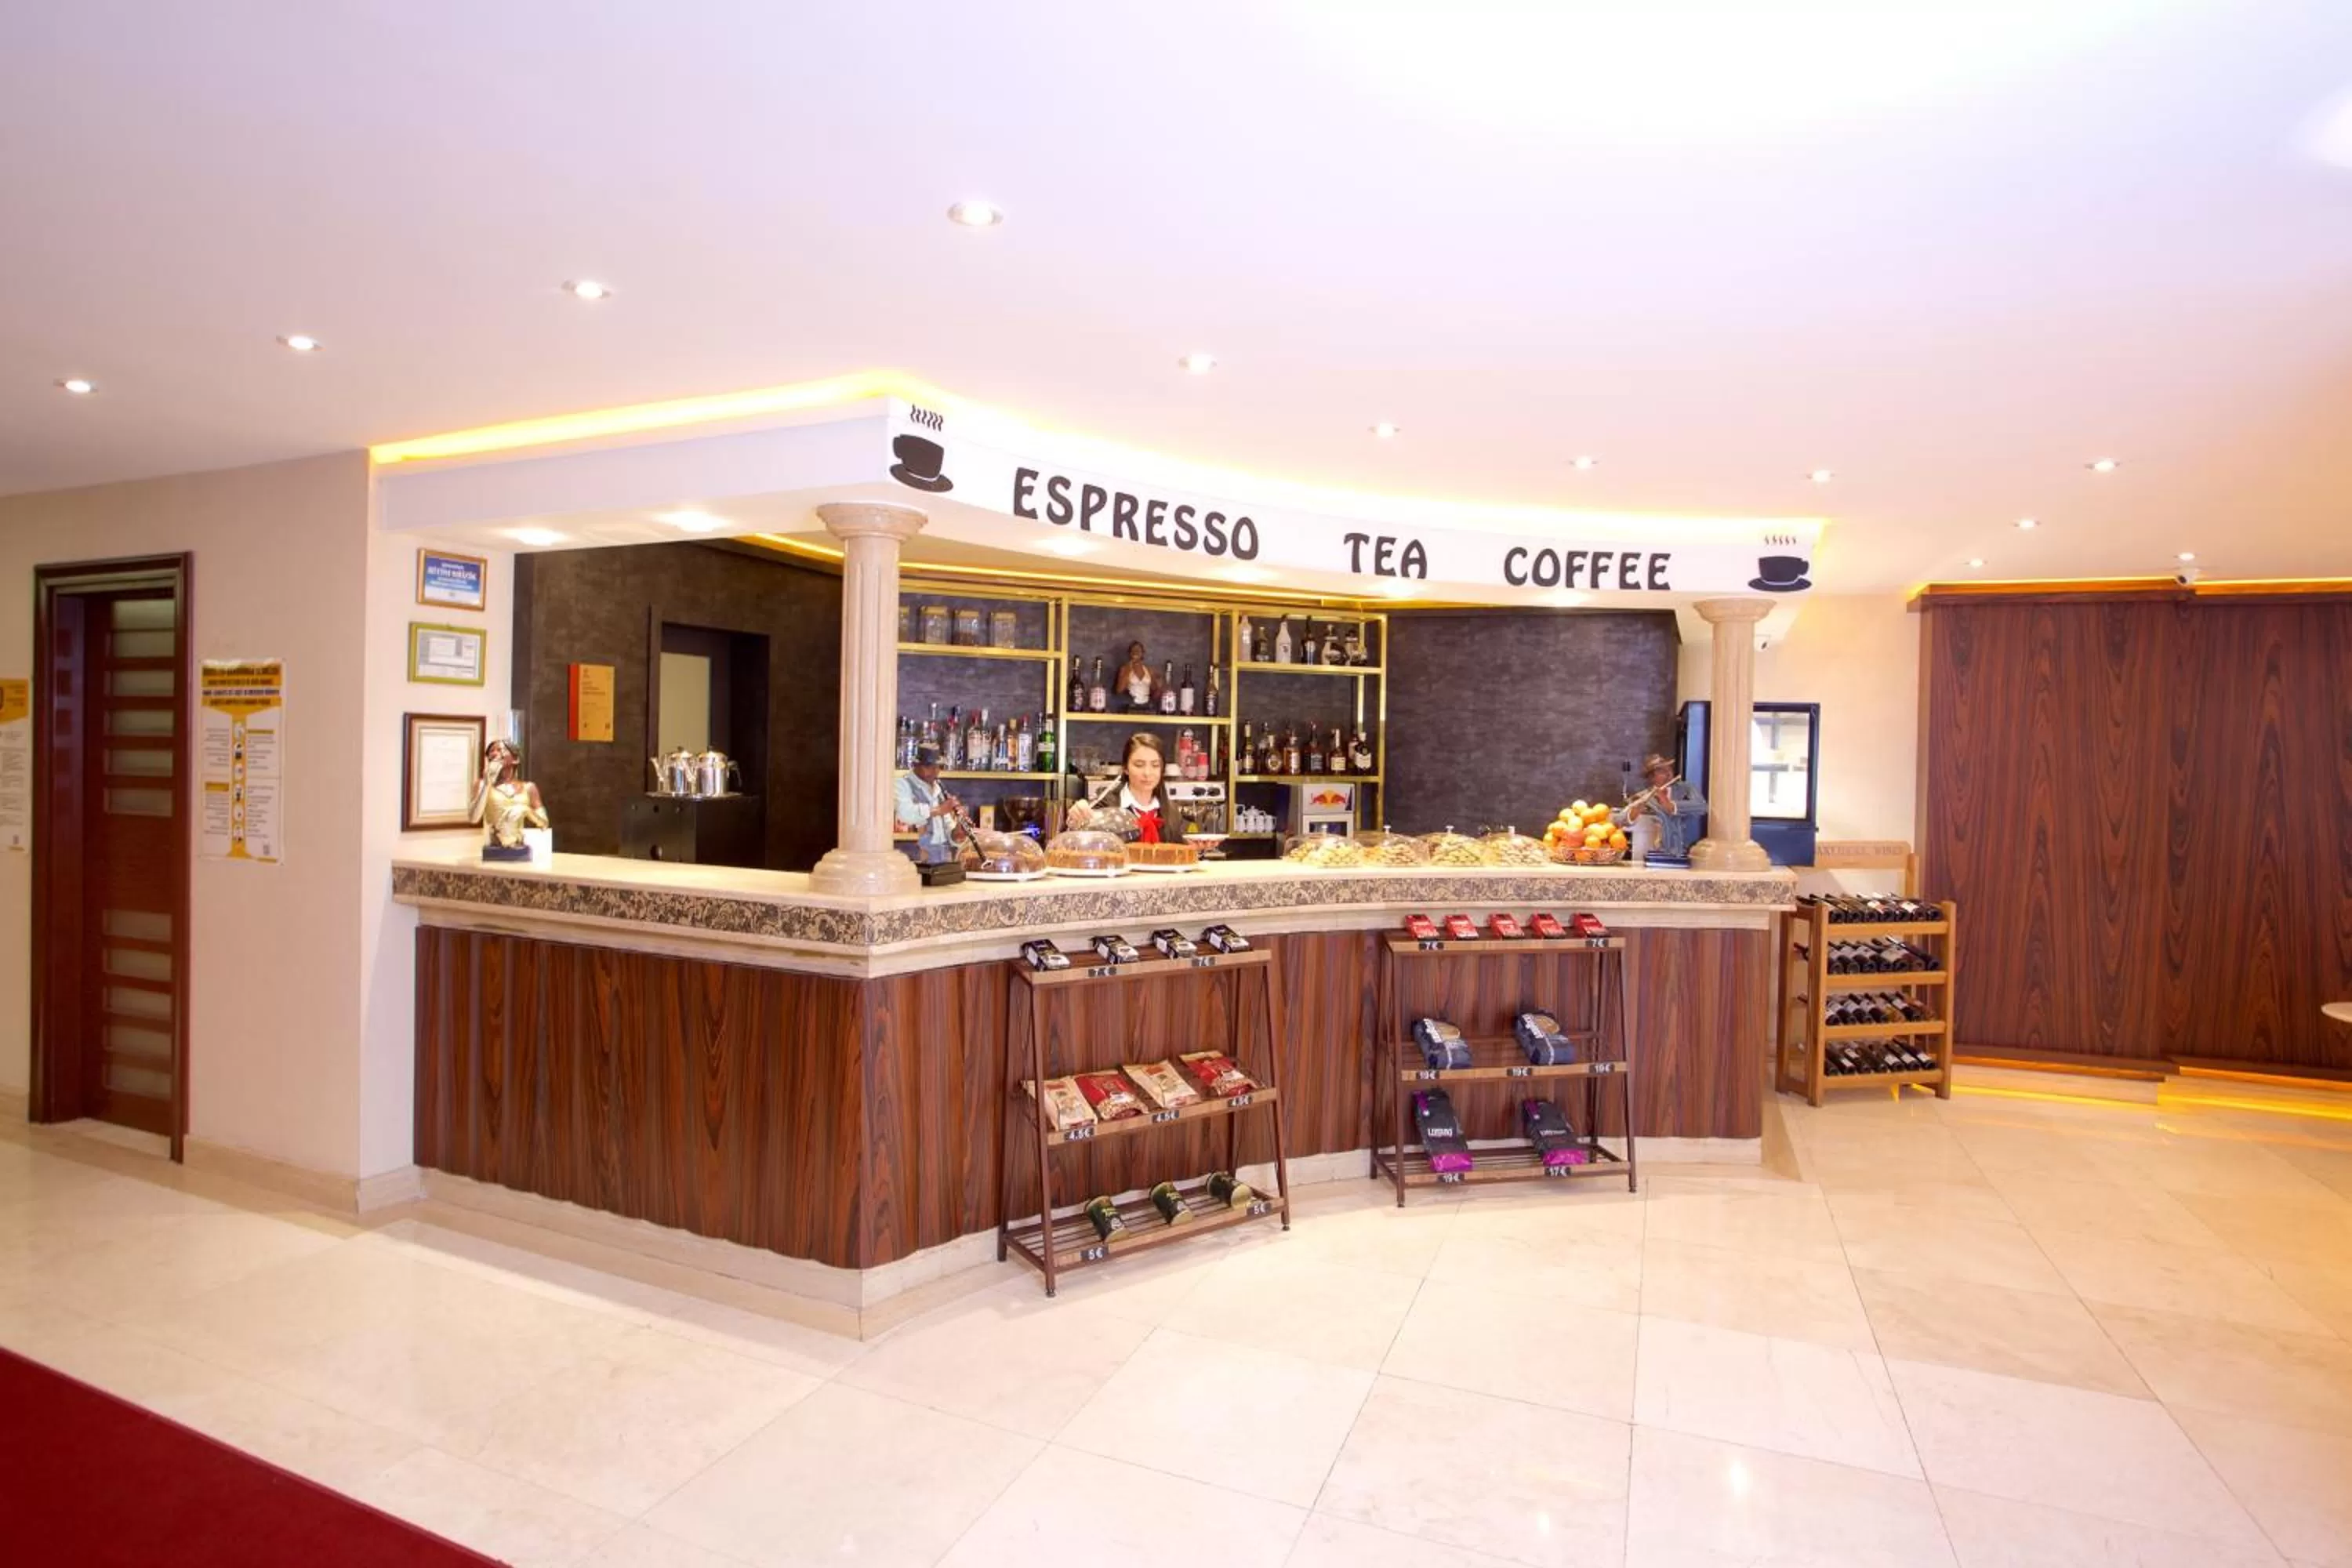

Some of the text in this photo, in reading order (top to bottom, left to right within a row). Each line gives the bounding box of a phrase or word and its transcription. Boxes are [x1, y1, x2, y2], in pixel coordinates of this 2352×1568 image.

[1014, 468, 1671, 590] ESPRESSO TEA COFFEE
